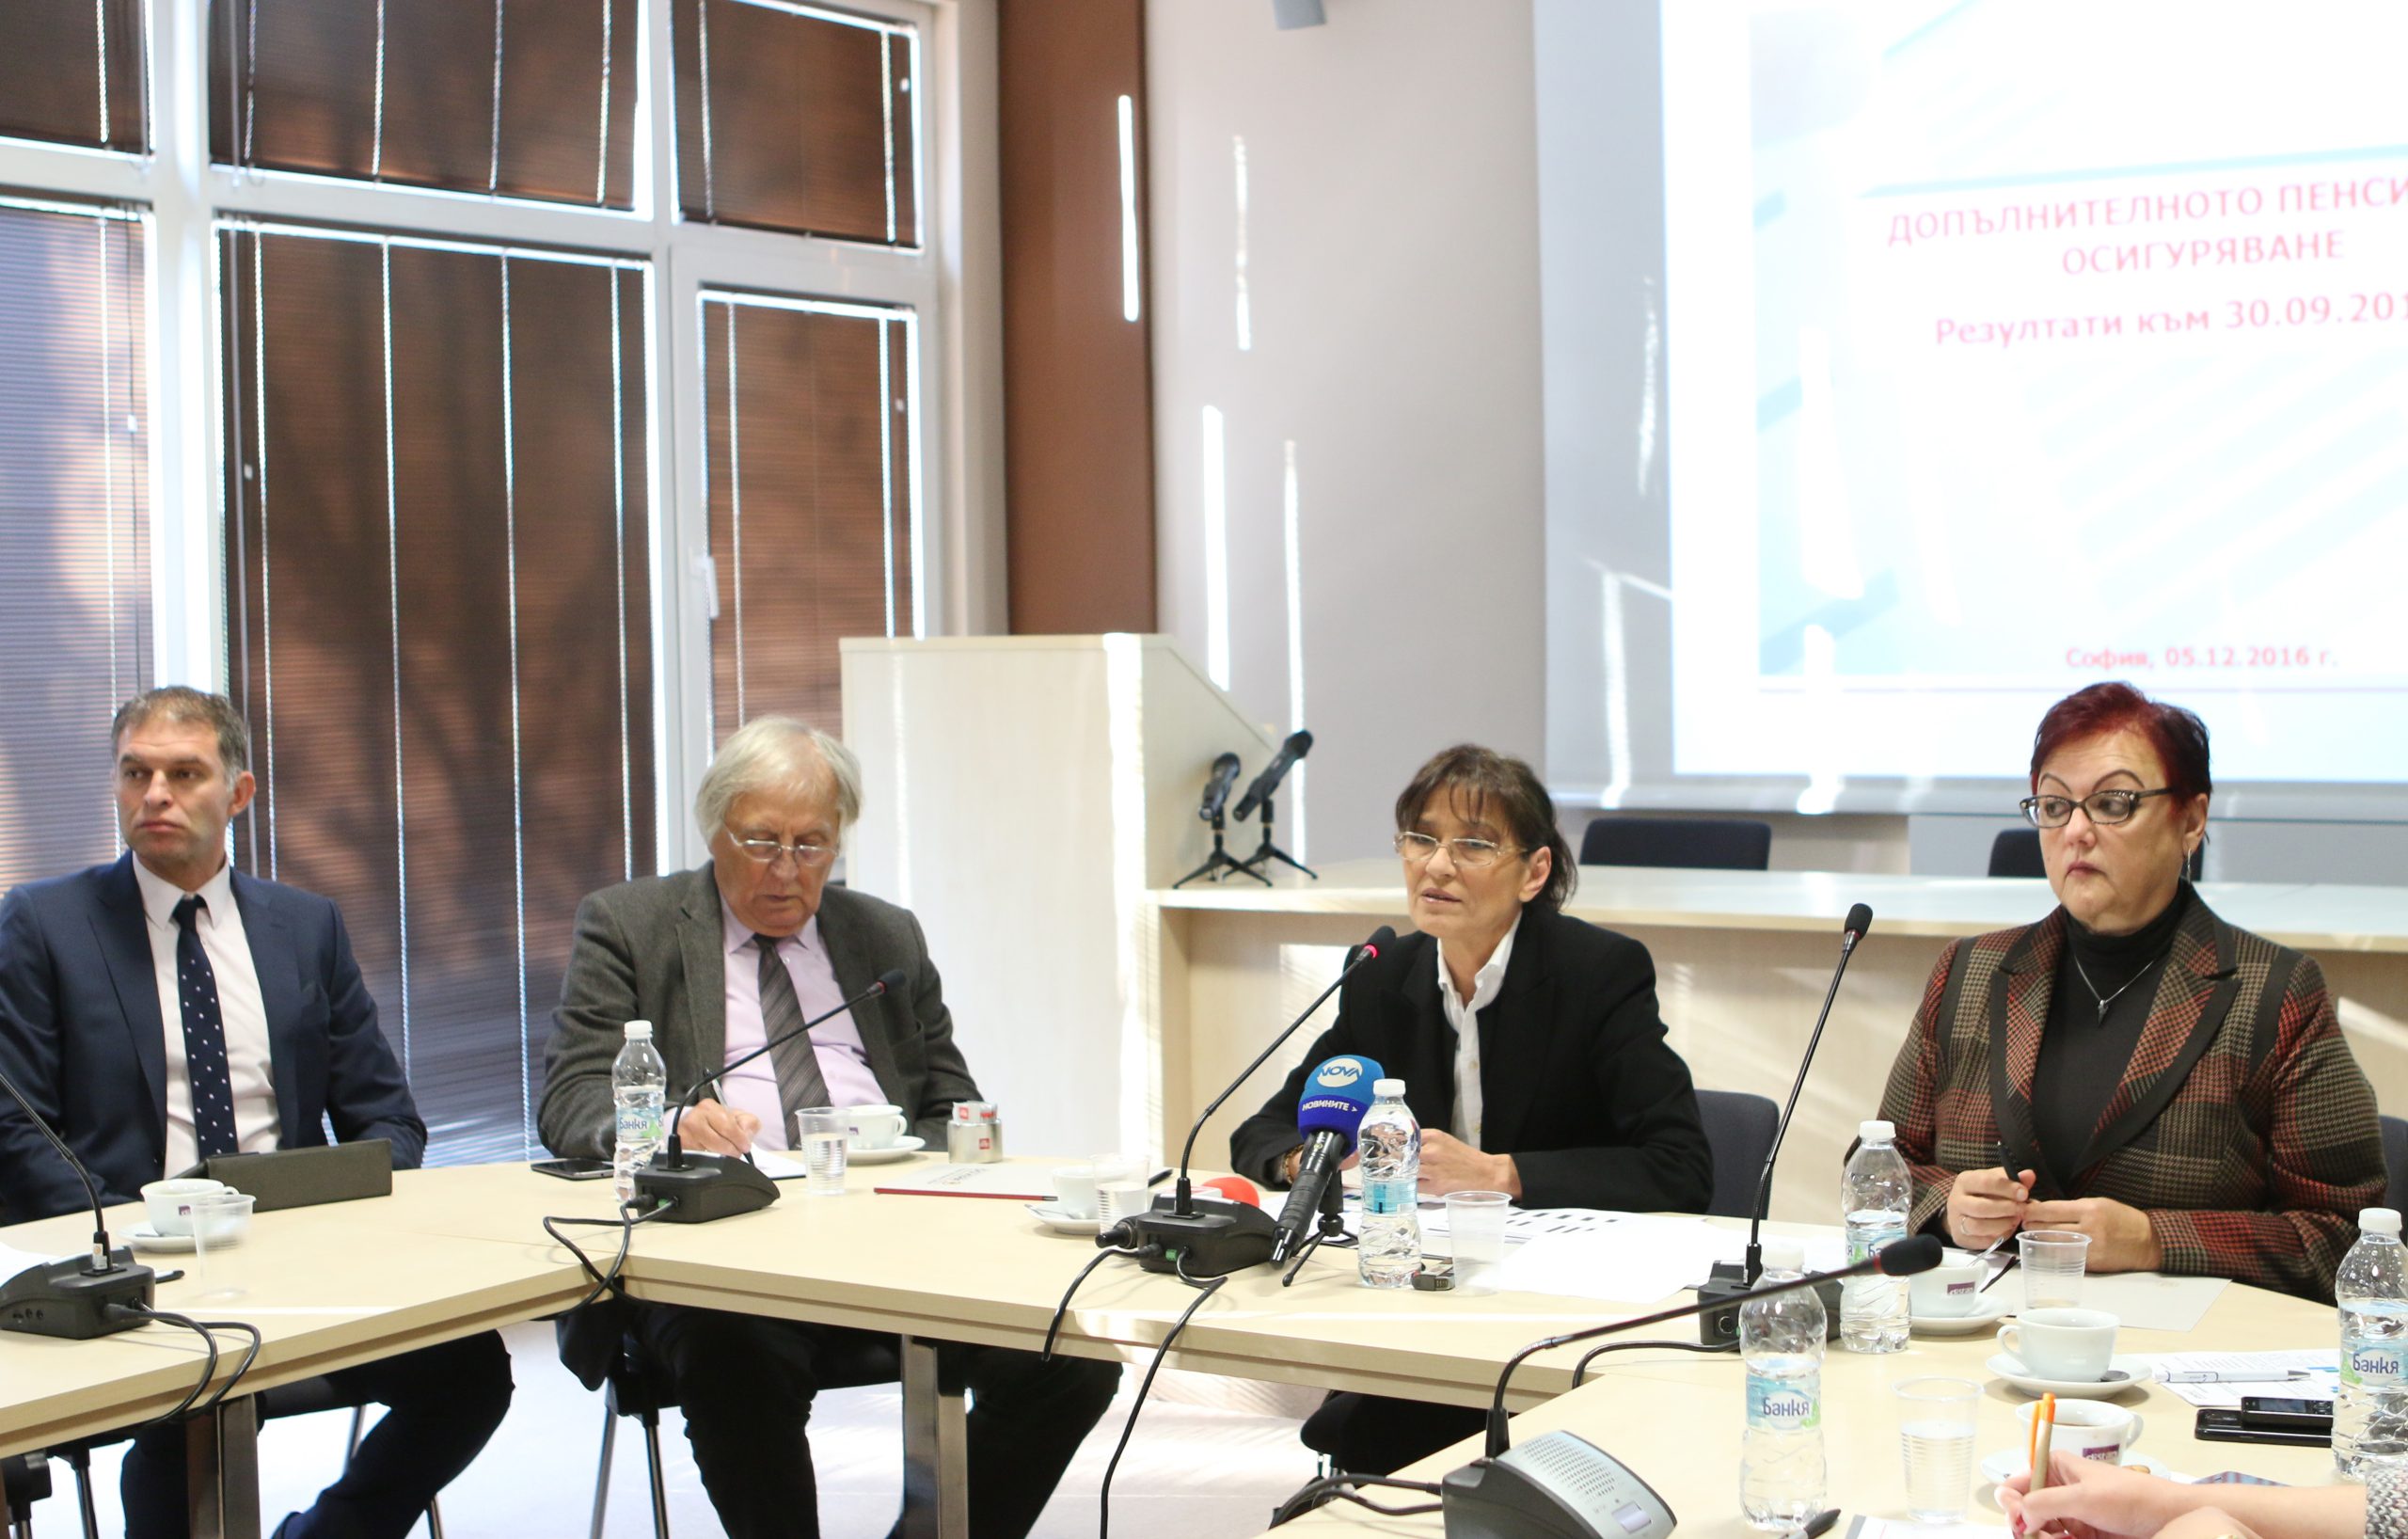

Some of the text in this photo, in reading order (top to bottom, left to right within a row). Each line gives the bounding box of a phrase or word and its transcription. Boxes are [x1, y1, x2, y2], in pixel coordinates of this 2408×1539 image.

[1888, 185, 2264, 247] ДОПЪЛНИТЕЛНОТО
[2062, 230, 2345, 275] ОСИГУРЯВАНЕ
[1935, 313, 2123, 348] Резултати
[2137, 309, 2210, 334] към
[2065, 646, 2154, 671] София,
[2164, 645, 2311, 668] 05.12.2016
[1317, 1065, 1361, 1078] NOVA
[1302, 1099, 1350, 1111] НОВИНИТЕ
